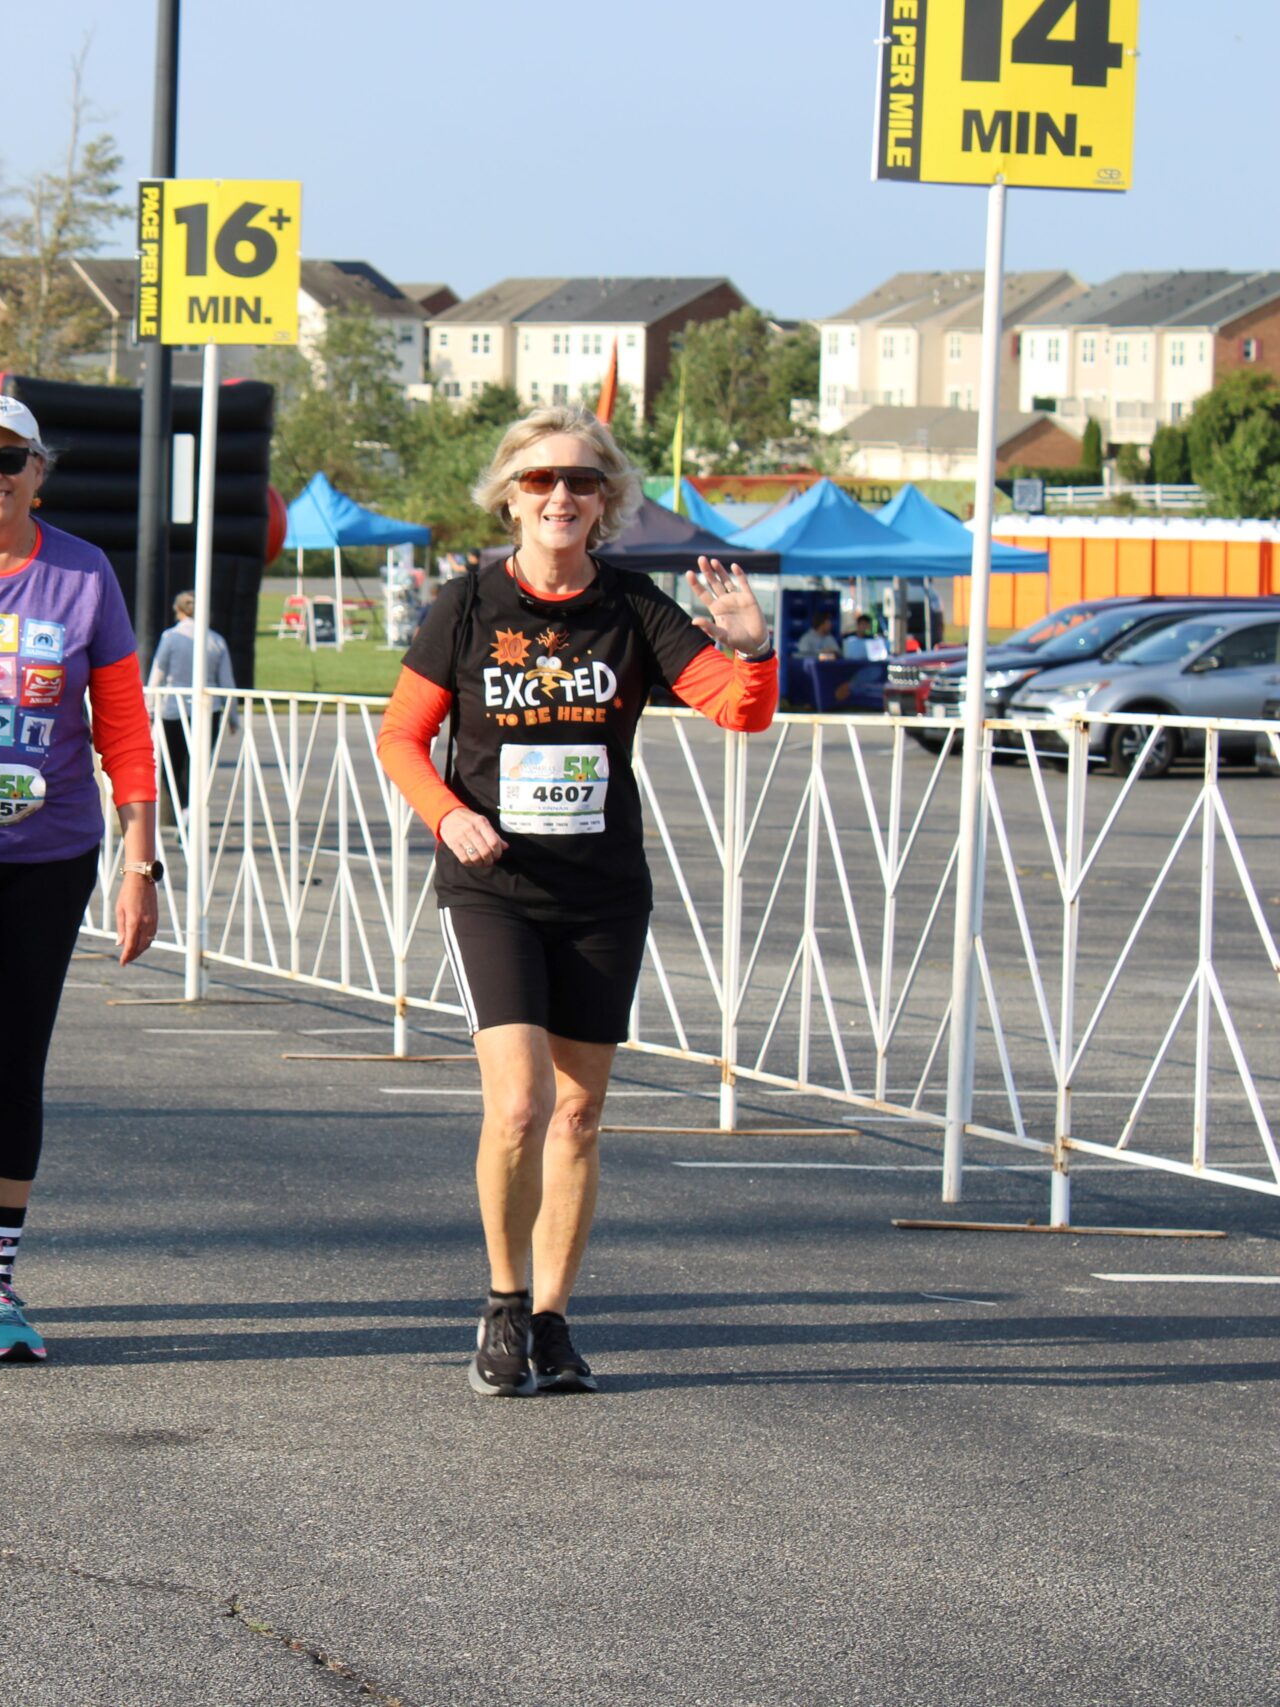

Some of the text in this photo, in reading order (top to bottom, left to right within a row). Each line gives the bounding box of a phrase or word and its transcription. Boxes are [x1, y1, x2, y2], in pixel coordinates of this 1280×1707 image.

[889, 26, 918, 88] PER
[961, 0, 1124, 87] 14
[886, 92, 914, 168] MILE
[961, 109, 1093, 157] MIN.
[139, 187, 161, 336] PACE PER MILE
[187, 296, 273, 325] MIN.
[495, 706, 607, 727] TO BE HERE
[563, 755, 601, 781] 5K
[532, 785, 594, 803] 4607
